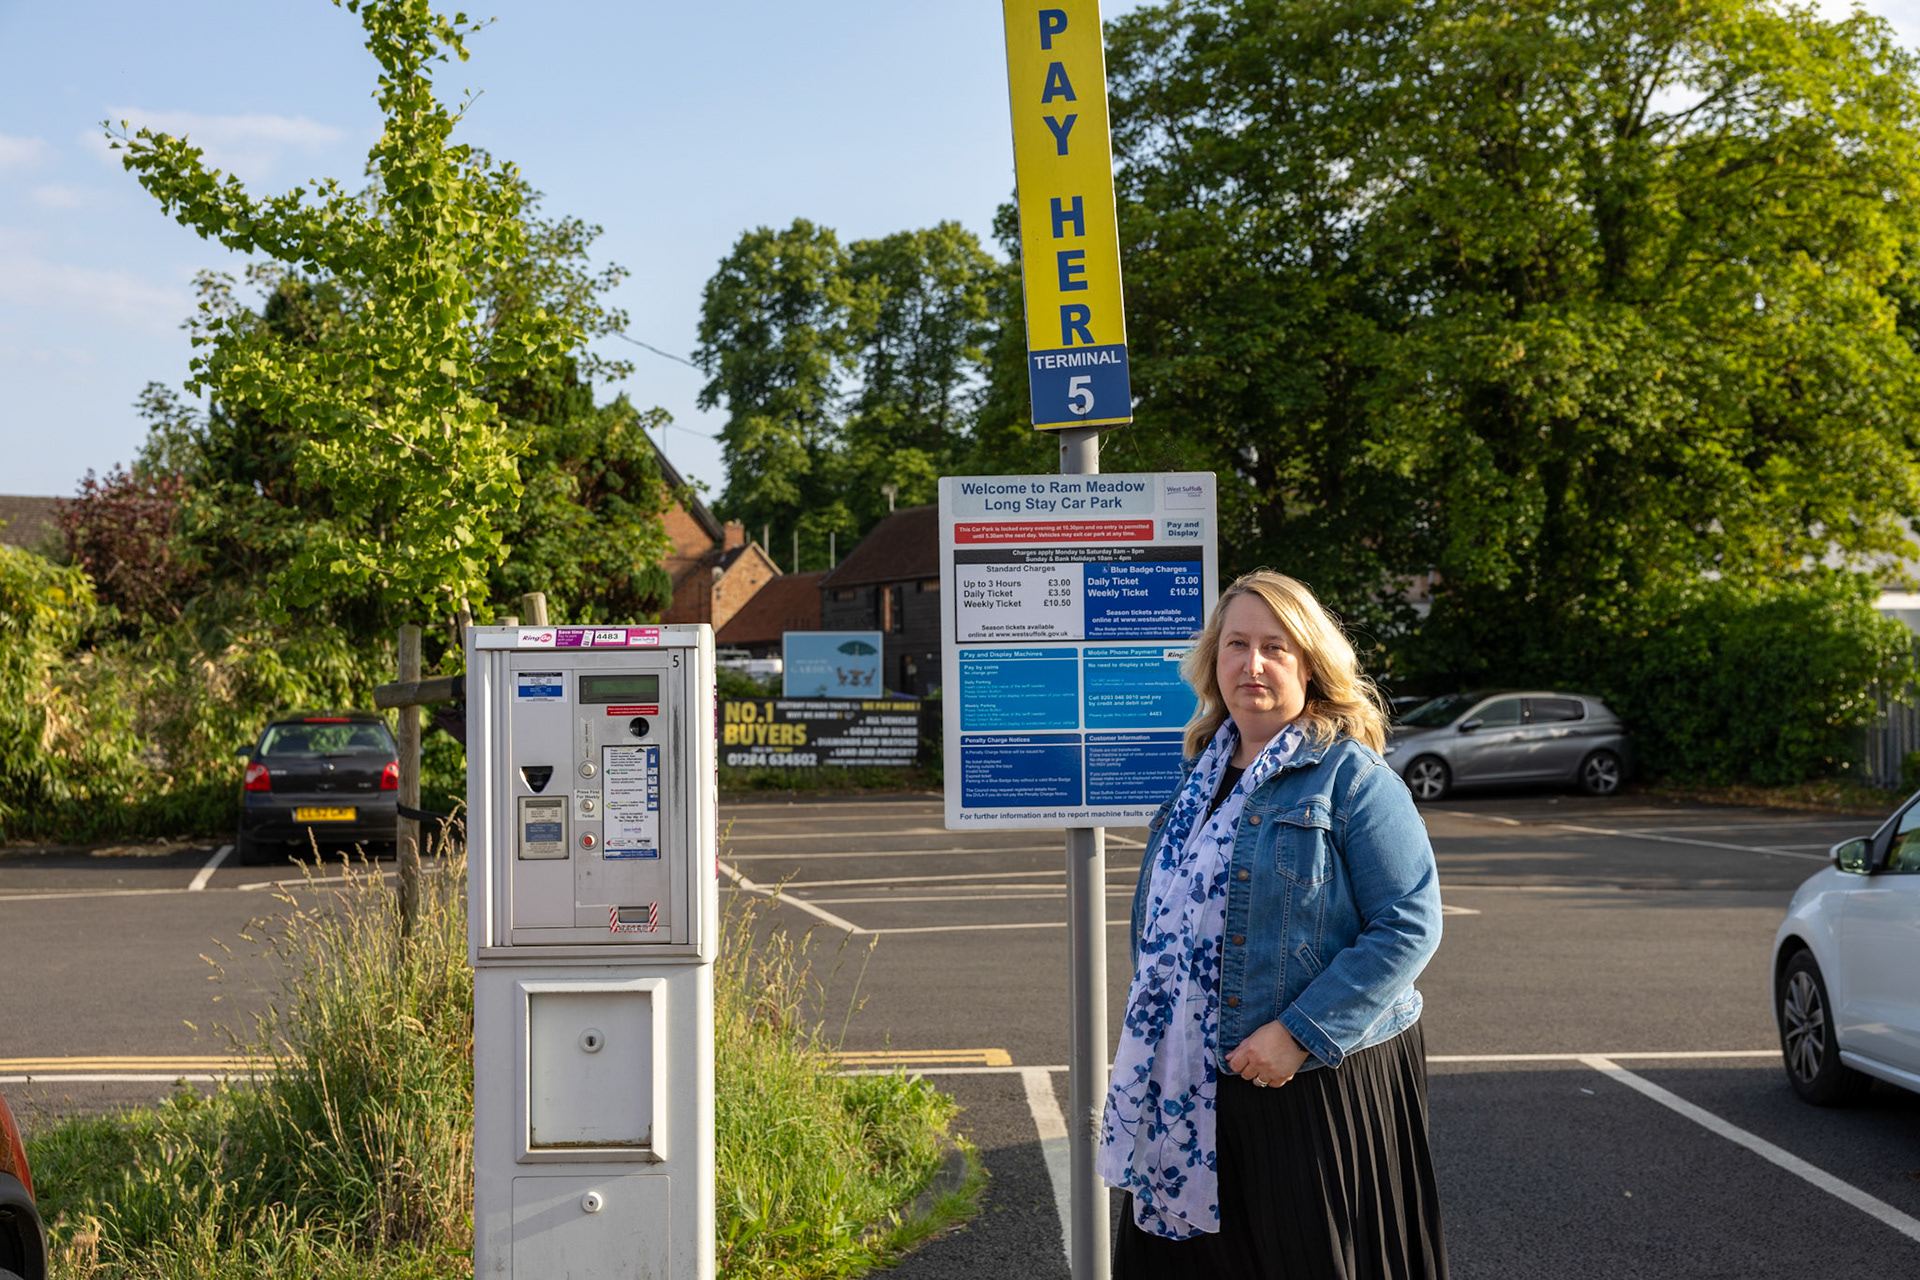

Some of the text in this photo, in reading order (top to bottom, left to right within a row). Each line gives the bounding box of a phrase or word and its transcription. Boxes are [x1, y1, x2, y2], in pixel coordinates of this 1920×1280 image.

[1038, 10, 1078, 156] PAY
[1034, 350, 1121, 370] TERMINAL
[1068, 375, 1094, 415] 5
[961, 480, 1145, 495] Welcome to Ram Meadow
[985, 496, 1122, 513] Long Stay Car Park
[1168, 530, 1198, 538] Display
[1022, 564, 1056, 573] Charges
[1129, 565, 1154, 575] Badge
[1155, 565, 1187, 574] Charges
[963, 580, 976, 589] Up
[1087, 576, 1139, 587] Daily Ticket
[1175, 576, 1199, 585] £3.00
[963, 589, 1013, 599] Daily Ticket
[1048, 588, 1071, 596] £3.50
[1087, 588, 1149, 599] Weekly Ticket
[1170, 588, 1199, 596] £10.50
[963, 600, 994, 609] Weekly
[1043, 599, 1071, 607] £10.50
[1120, 615, 1196, 624] www.westsuffolk.gov.uk
[995, 630, 1068, 638] www.westsuffolk.gov.uk
[672, 655, 679, 668] 5
[724, 701, 774, 723] NO.1
[724, 724, 807, 745] BUYERS
